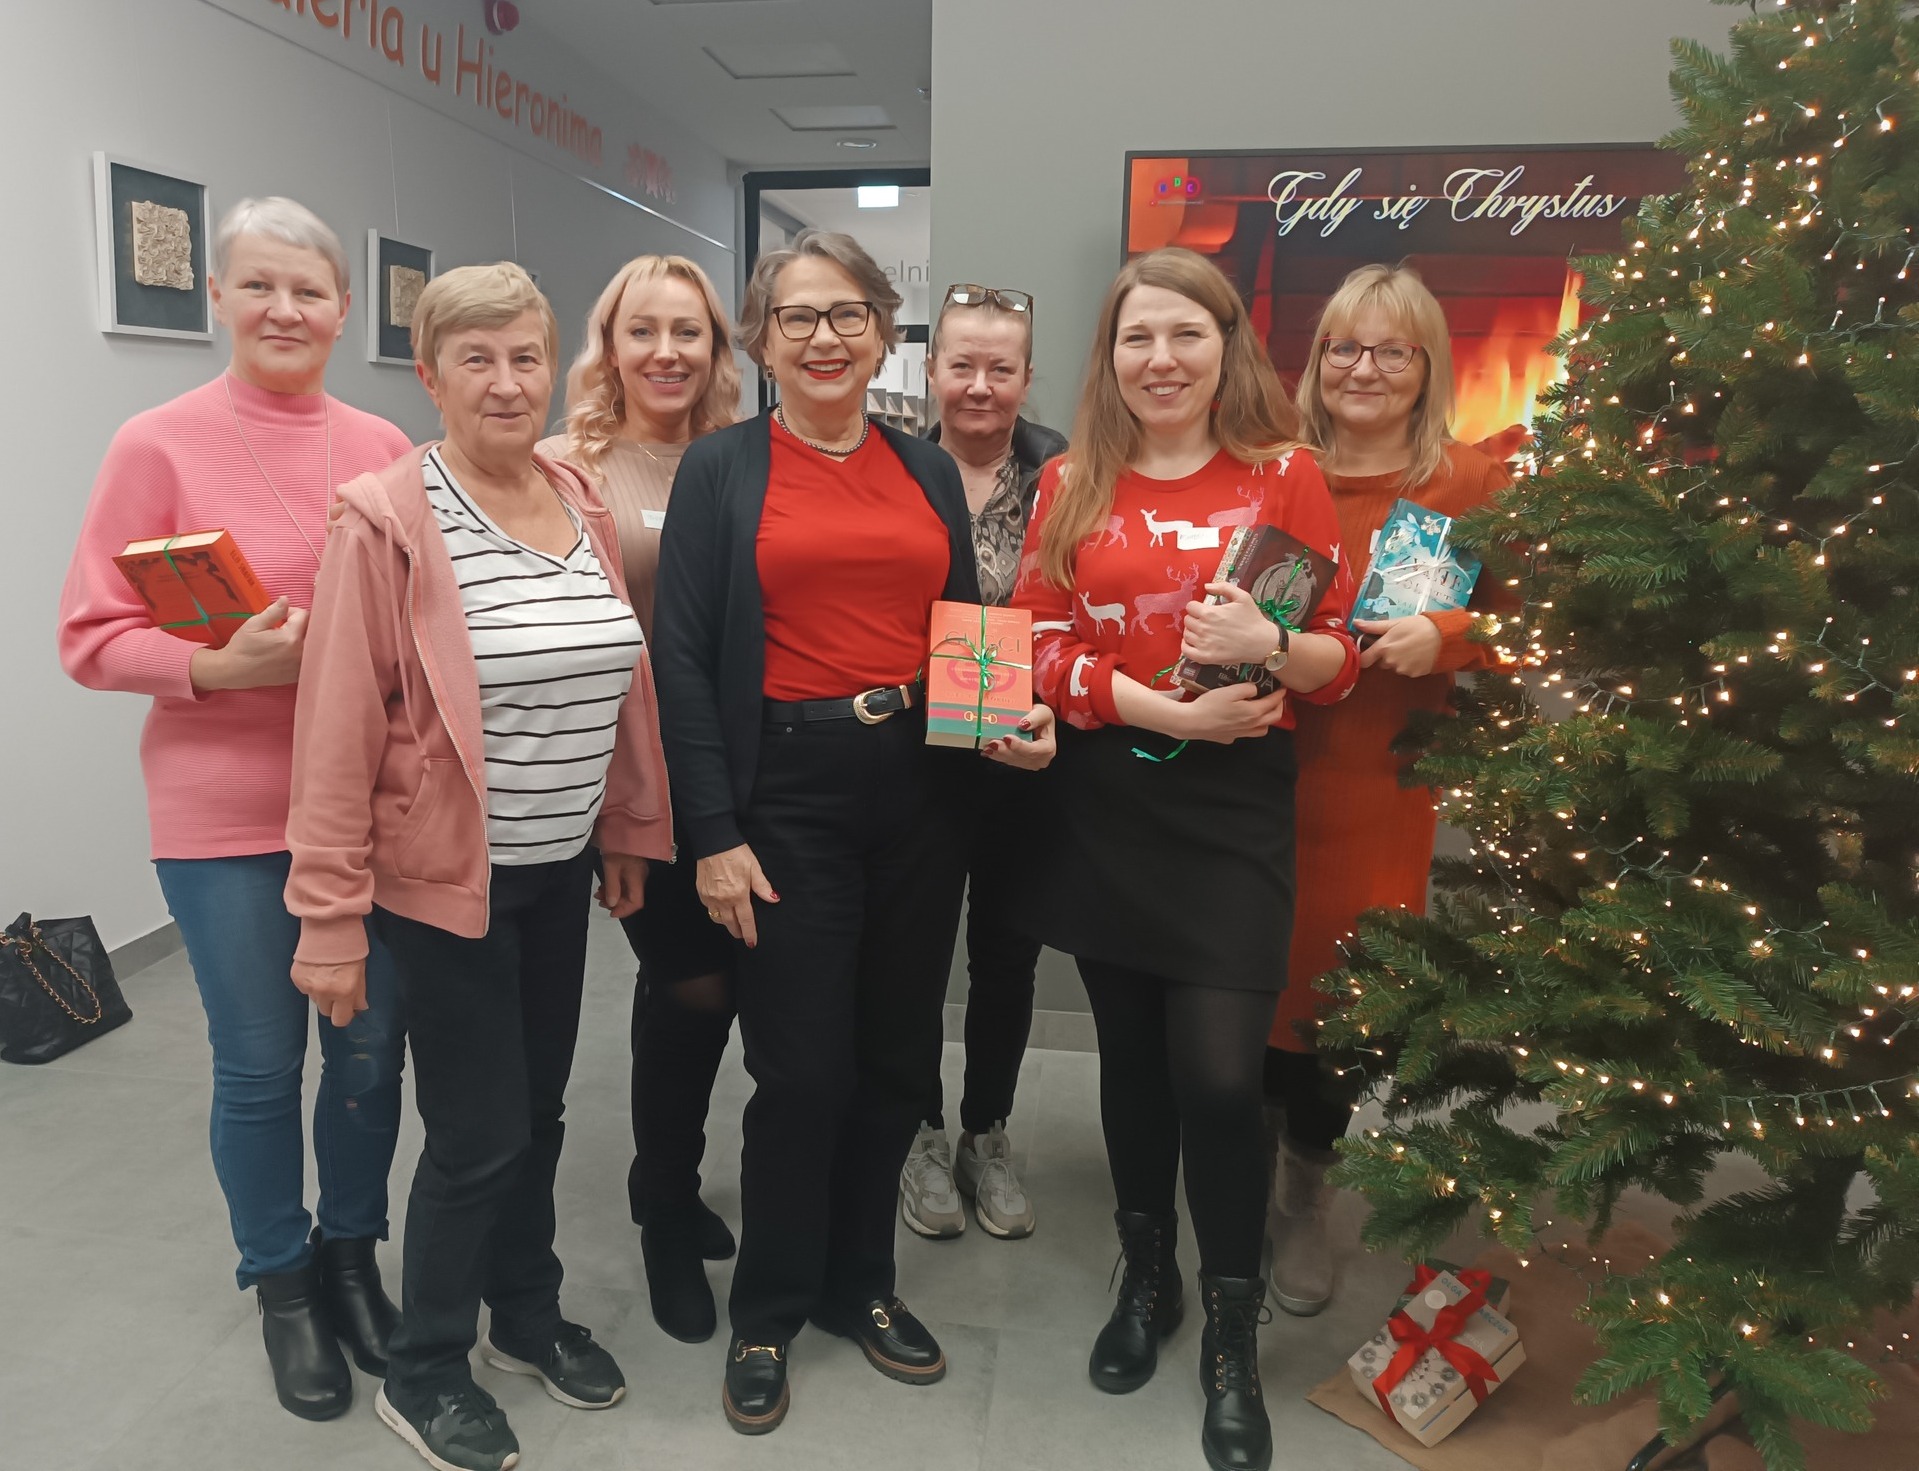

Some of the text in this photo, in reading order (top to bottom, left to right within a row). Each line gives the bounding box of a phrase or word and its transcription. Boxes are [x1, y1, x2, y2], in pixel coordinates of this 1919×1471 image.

[421, 24, 442, 85] u
[455, 23, 603, 169] Hieronima
[1267, 165, 1627, 238] Gdy się Chrystus
[945, 630, 1020, 654] GUCI
[1221, 663, 1275, 693] ARDA
[1441, 1277, 1463, 1298] OLGA
